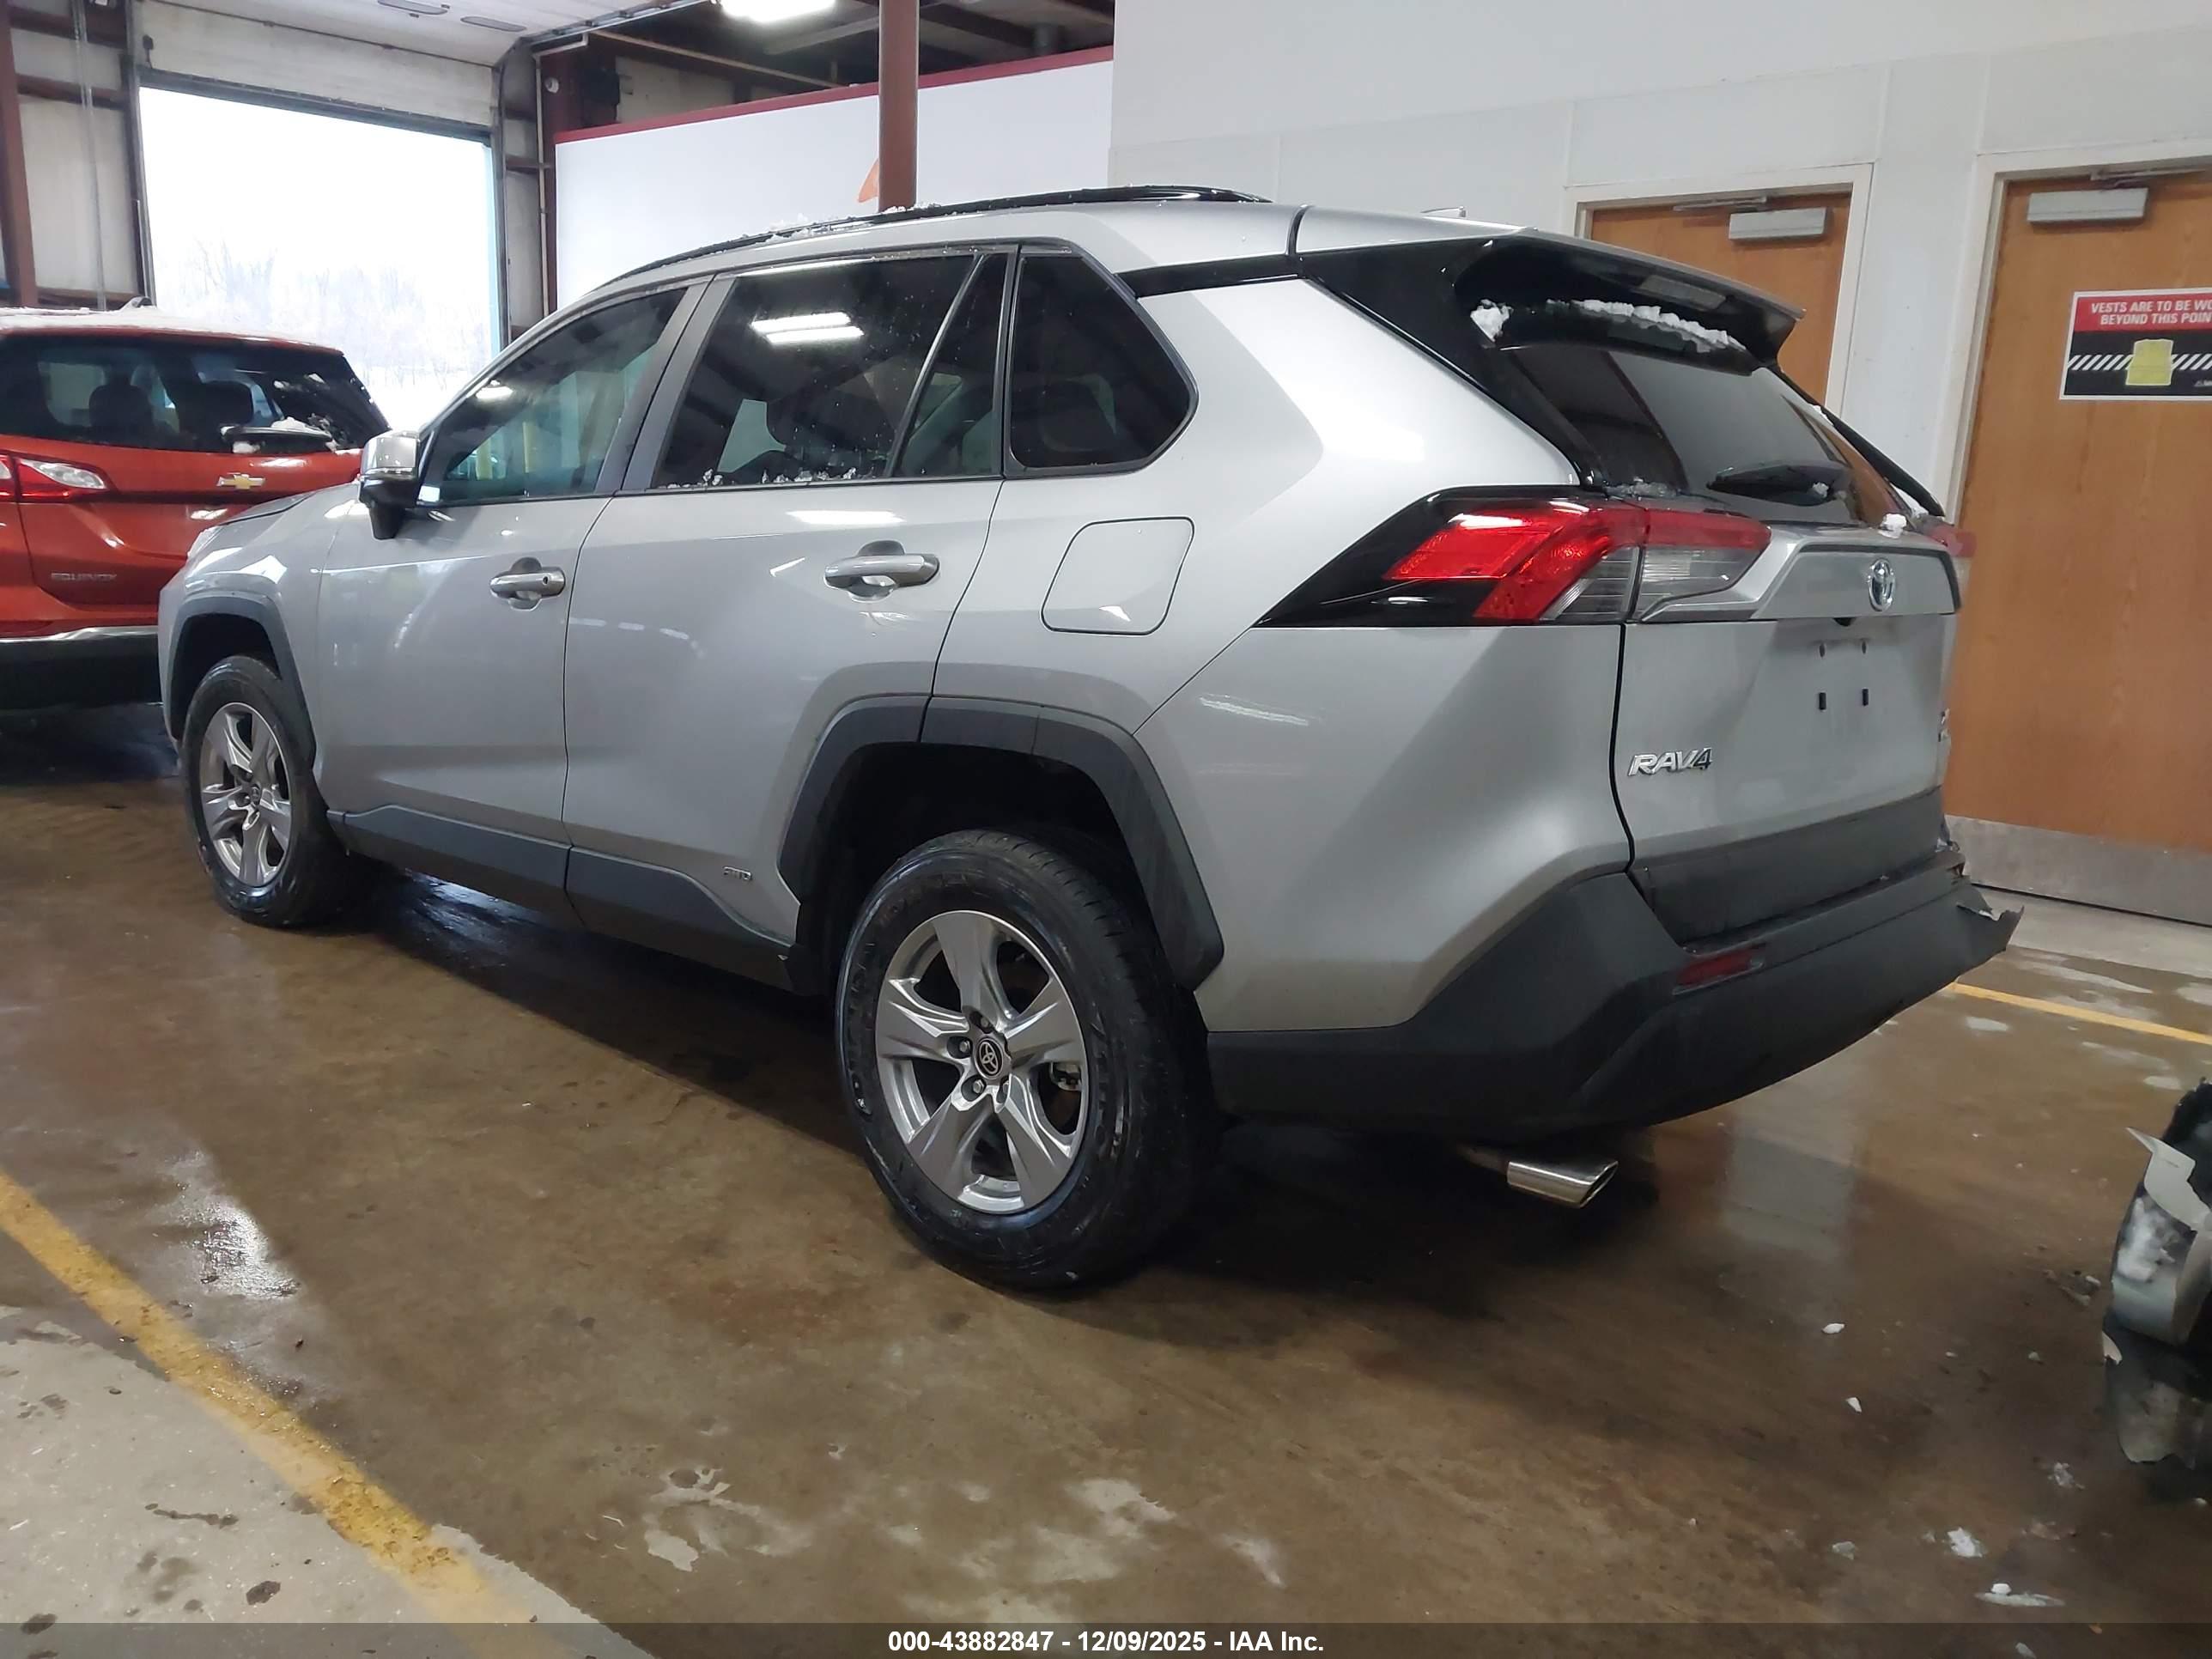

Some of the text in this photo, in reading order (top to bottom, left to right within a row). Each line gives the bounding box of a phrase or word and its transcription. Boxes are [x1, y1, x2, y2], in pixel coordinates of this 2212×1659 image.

[2091, 301, 2128, 313] VESTS
[2130, 301, 2154, 313] ARE
[2156, 301, 2172, 312] TO
[2175, 300, 2192, 311] BE
[2100, 313, 2148, 325] BEYOND
[2151, 313, 2178, 325] THIS
[1627, 746, 1714, 776] RAV4
